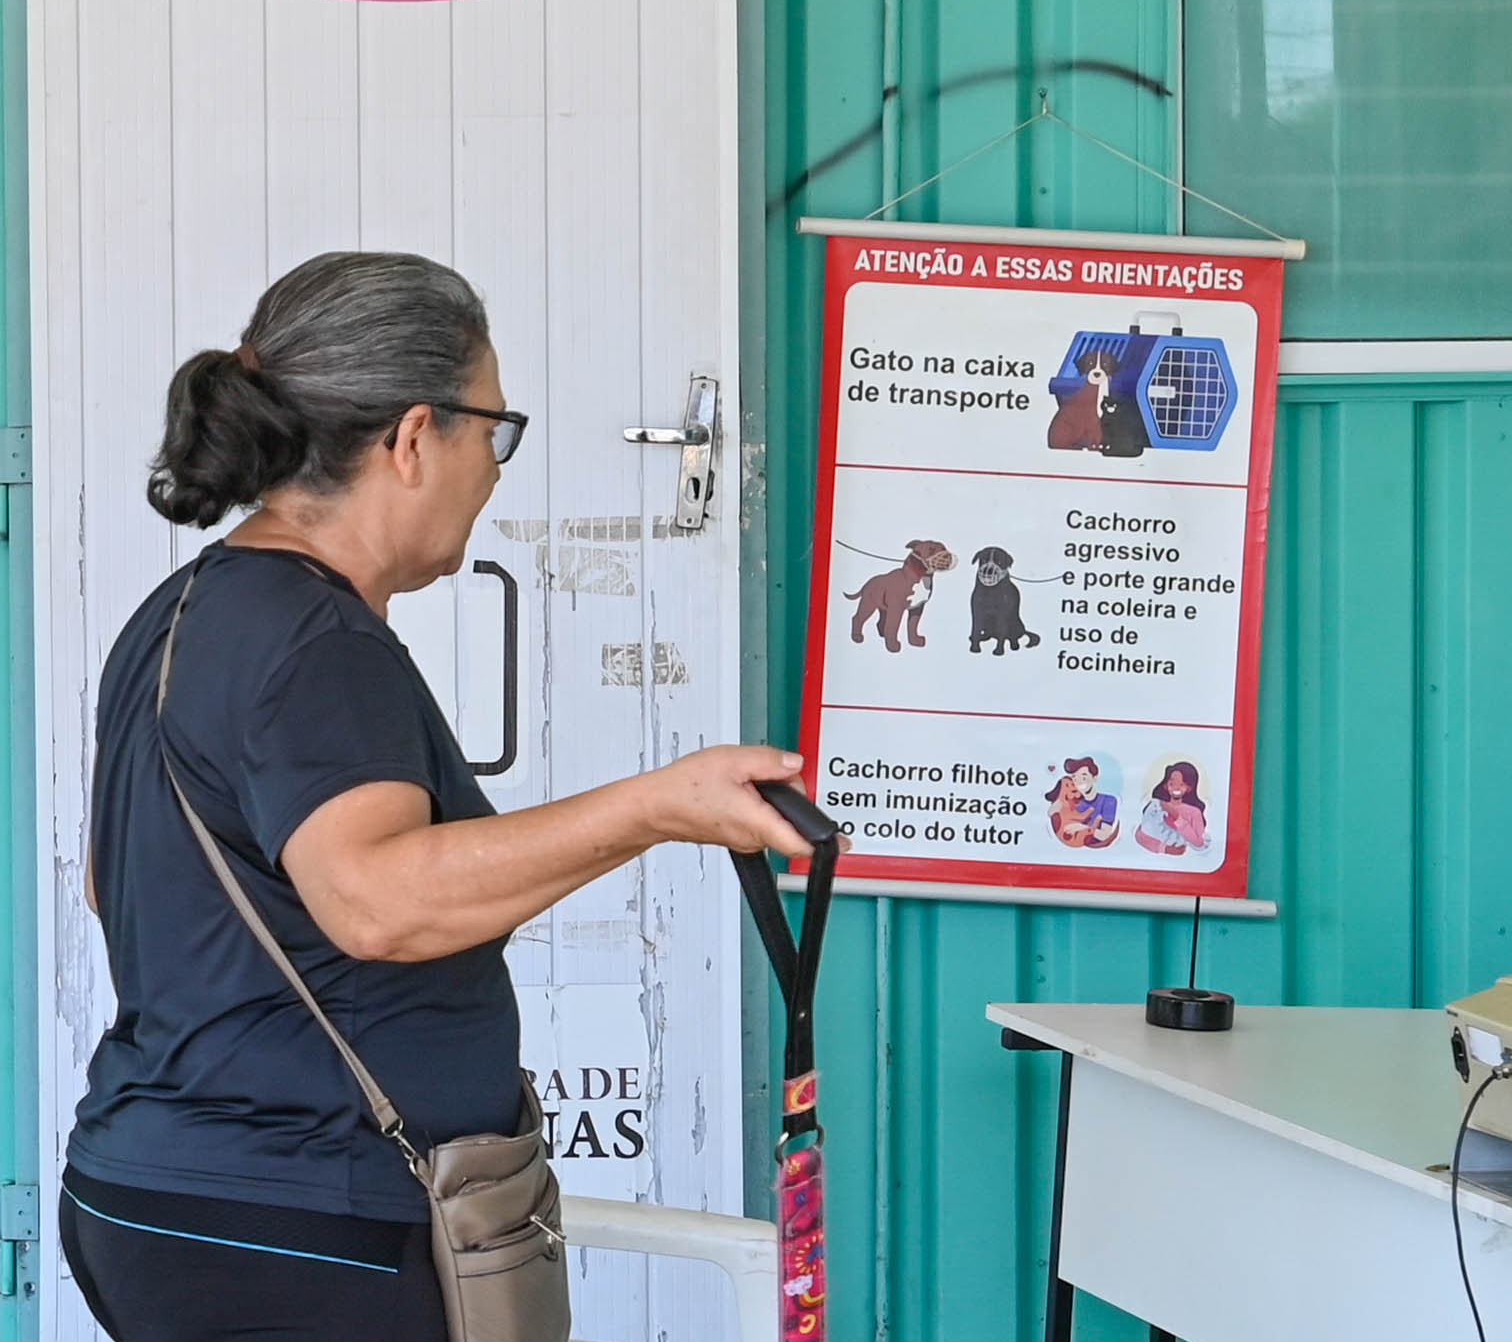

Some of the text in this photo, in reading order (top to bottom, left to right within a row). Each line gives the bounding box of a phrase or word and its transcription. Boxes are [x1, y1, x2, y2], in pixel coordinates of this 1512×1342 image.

[854, 247, 1244, 294] ATENÇÃO A ESSAS ORIENTAÇÕES
[850, 347, 1035, 378] Gato na caixa
[848, 380, 1030, 413] de transporte
[1066, 509, 1176, 535] Cachorro
[1064, 539, 1180, 565] agressivo
[1062, 570, 1235, 596] e porte grande
[1061, 596, 1197, 620] na coleira e
[1059, 625, 1138, 645] uso de
[1057, 651, 1175, 675] focinheira
[828, 757, 1028, 788] Cachorro filhote
[826, 790, 1027, 820] sem imunização
[863, 818, 915, 840] colo
[924, 821, 955, 843] do
[964, 825, 1023, 847] tutor
[578, 1067, 642, 1100] DE
